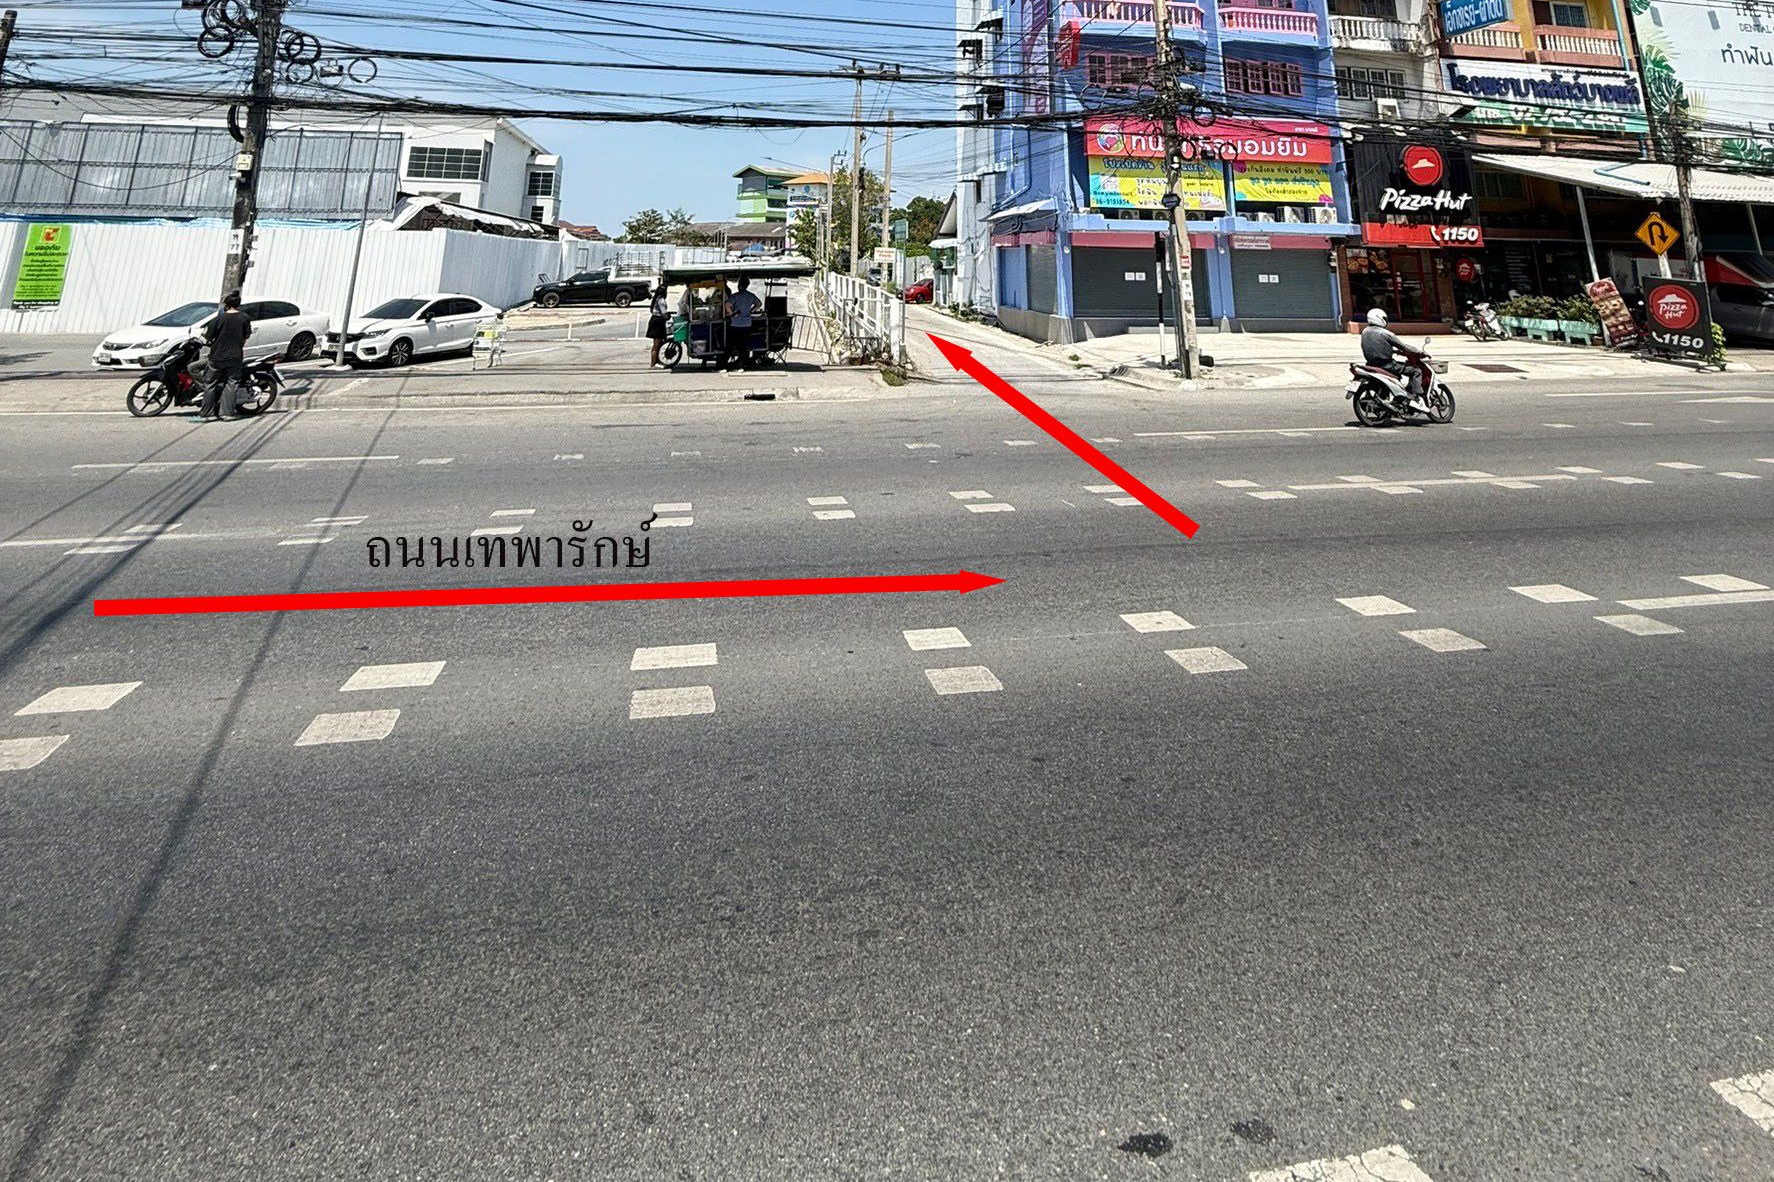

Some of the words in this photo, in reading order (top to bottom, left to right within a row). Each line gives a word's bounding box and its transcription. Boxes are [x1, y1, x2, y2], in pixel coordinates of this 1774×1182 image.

[1447, 63, 1641, 105] โรงพยาบาลสัตว์บางพลี
[1380, 187, 1433, 211] Pizza
[1433, 189, 1473, 211] Hut
[1442, 227, 1479, 241] 1150
[1659, 303, 1688, 315] Pizza
[1664, 309, 1686, 320] Hut
[1662, 333, 1704, 349] 1150
